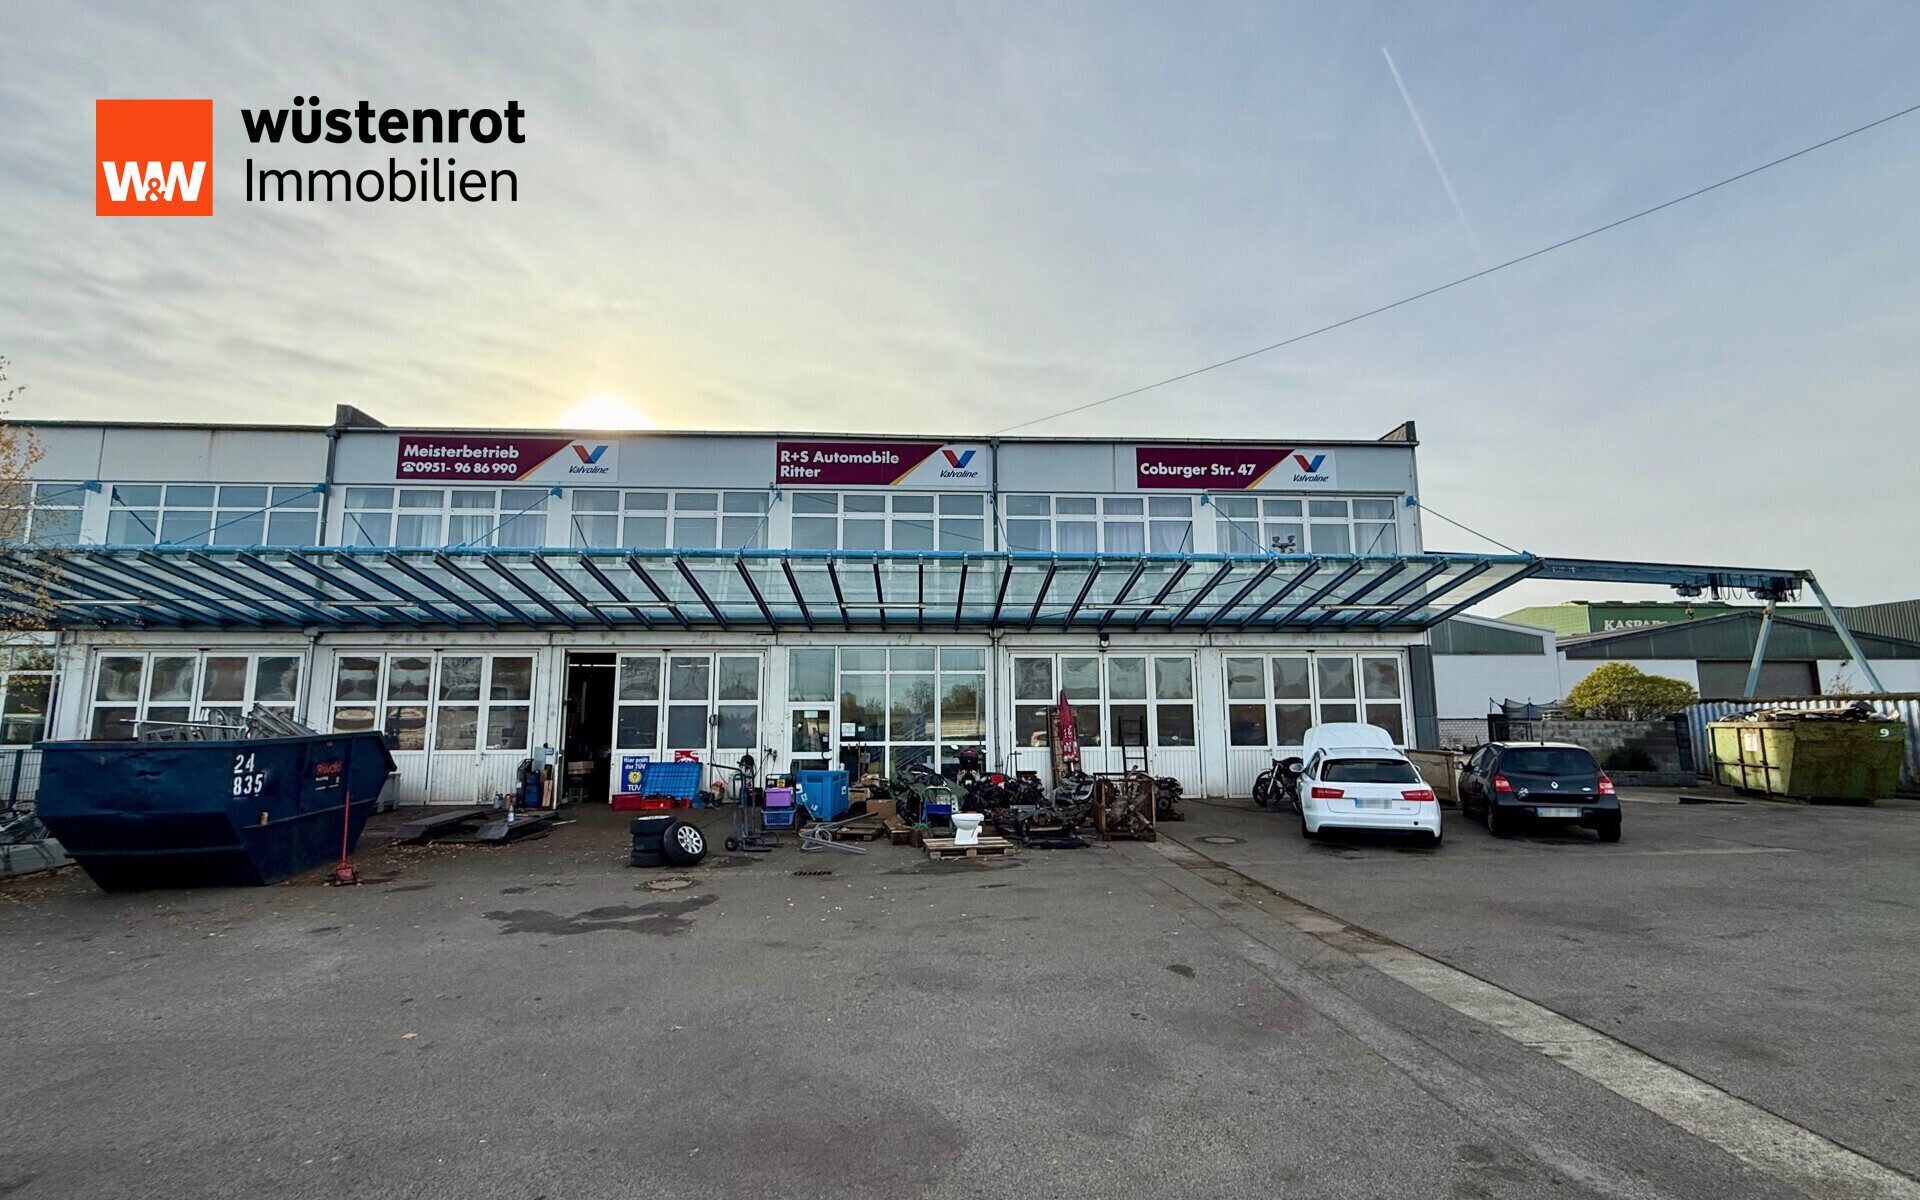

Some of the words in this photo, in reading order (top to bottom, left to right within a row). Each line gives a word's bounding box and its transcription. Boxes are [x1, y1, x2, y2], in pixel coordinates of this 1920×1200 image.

[403, 444, 520, 459] Meisterbetrieb
[780, 450, 809, 463] R+S
[813, 450, 900, 464] Automobile
[415, 461, 451, 473] 0951-
[454, 462, 471, 473] 96
[473, 462, 490, 473] 86
[491, 462, 518, 474] 990
[568, 465, 610, 475] Valvoline
[780, 465, 821, 478] Ritter
[939, 469, 979, 479] Valvoline
[1140, 462, 1208, 479] Coburger
[1210, 463, 1235, 476] Str.
[1237, 463, 1257, 476] 47
[1292, 474, 1330, 483] Valvoline
[1879, 728, 1890, 738] 9
[233, 752, 255, 774] 24
[232, 773, 263, 796] 835
